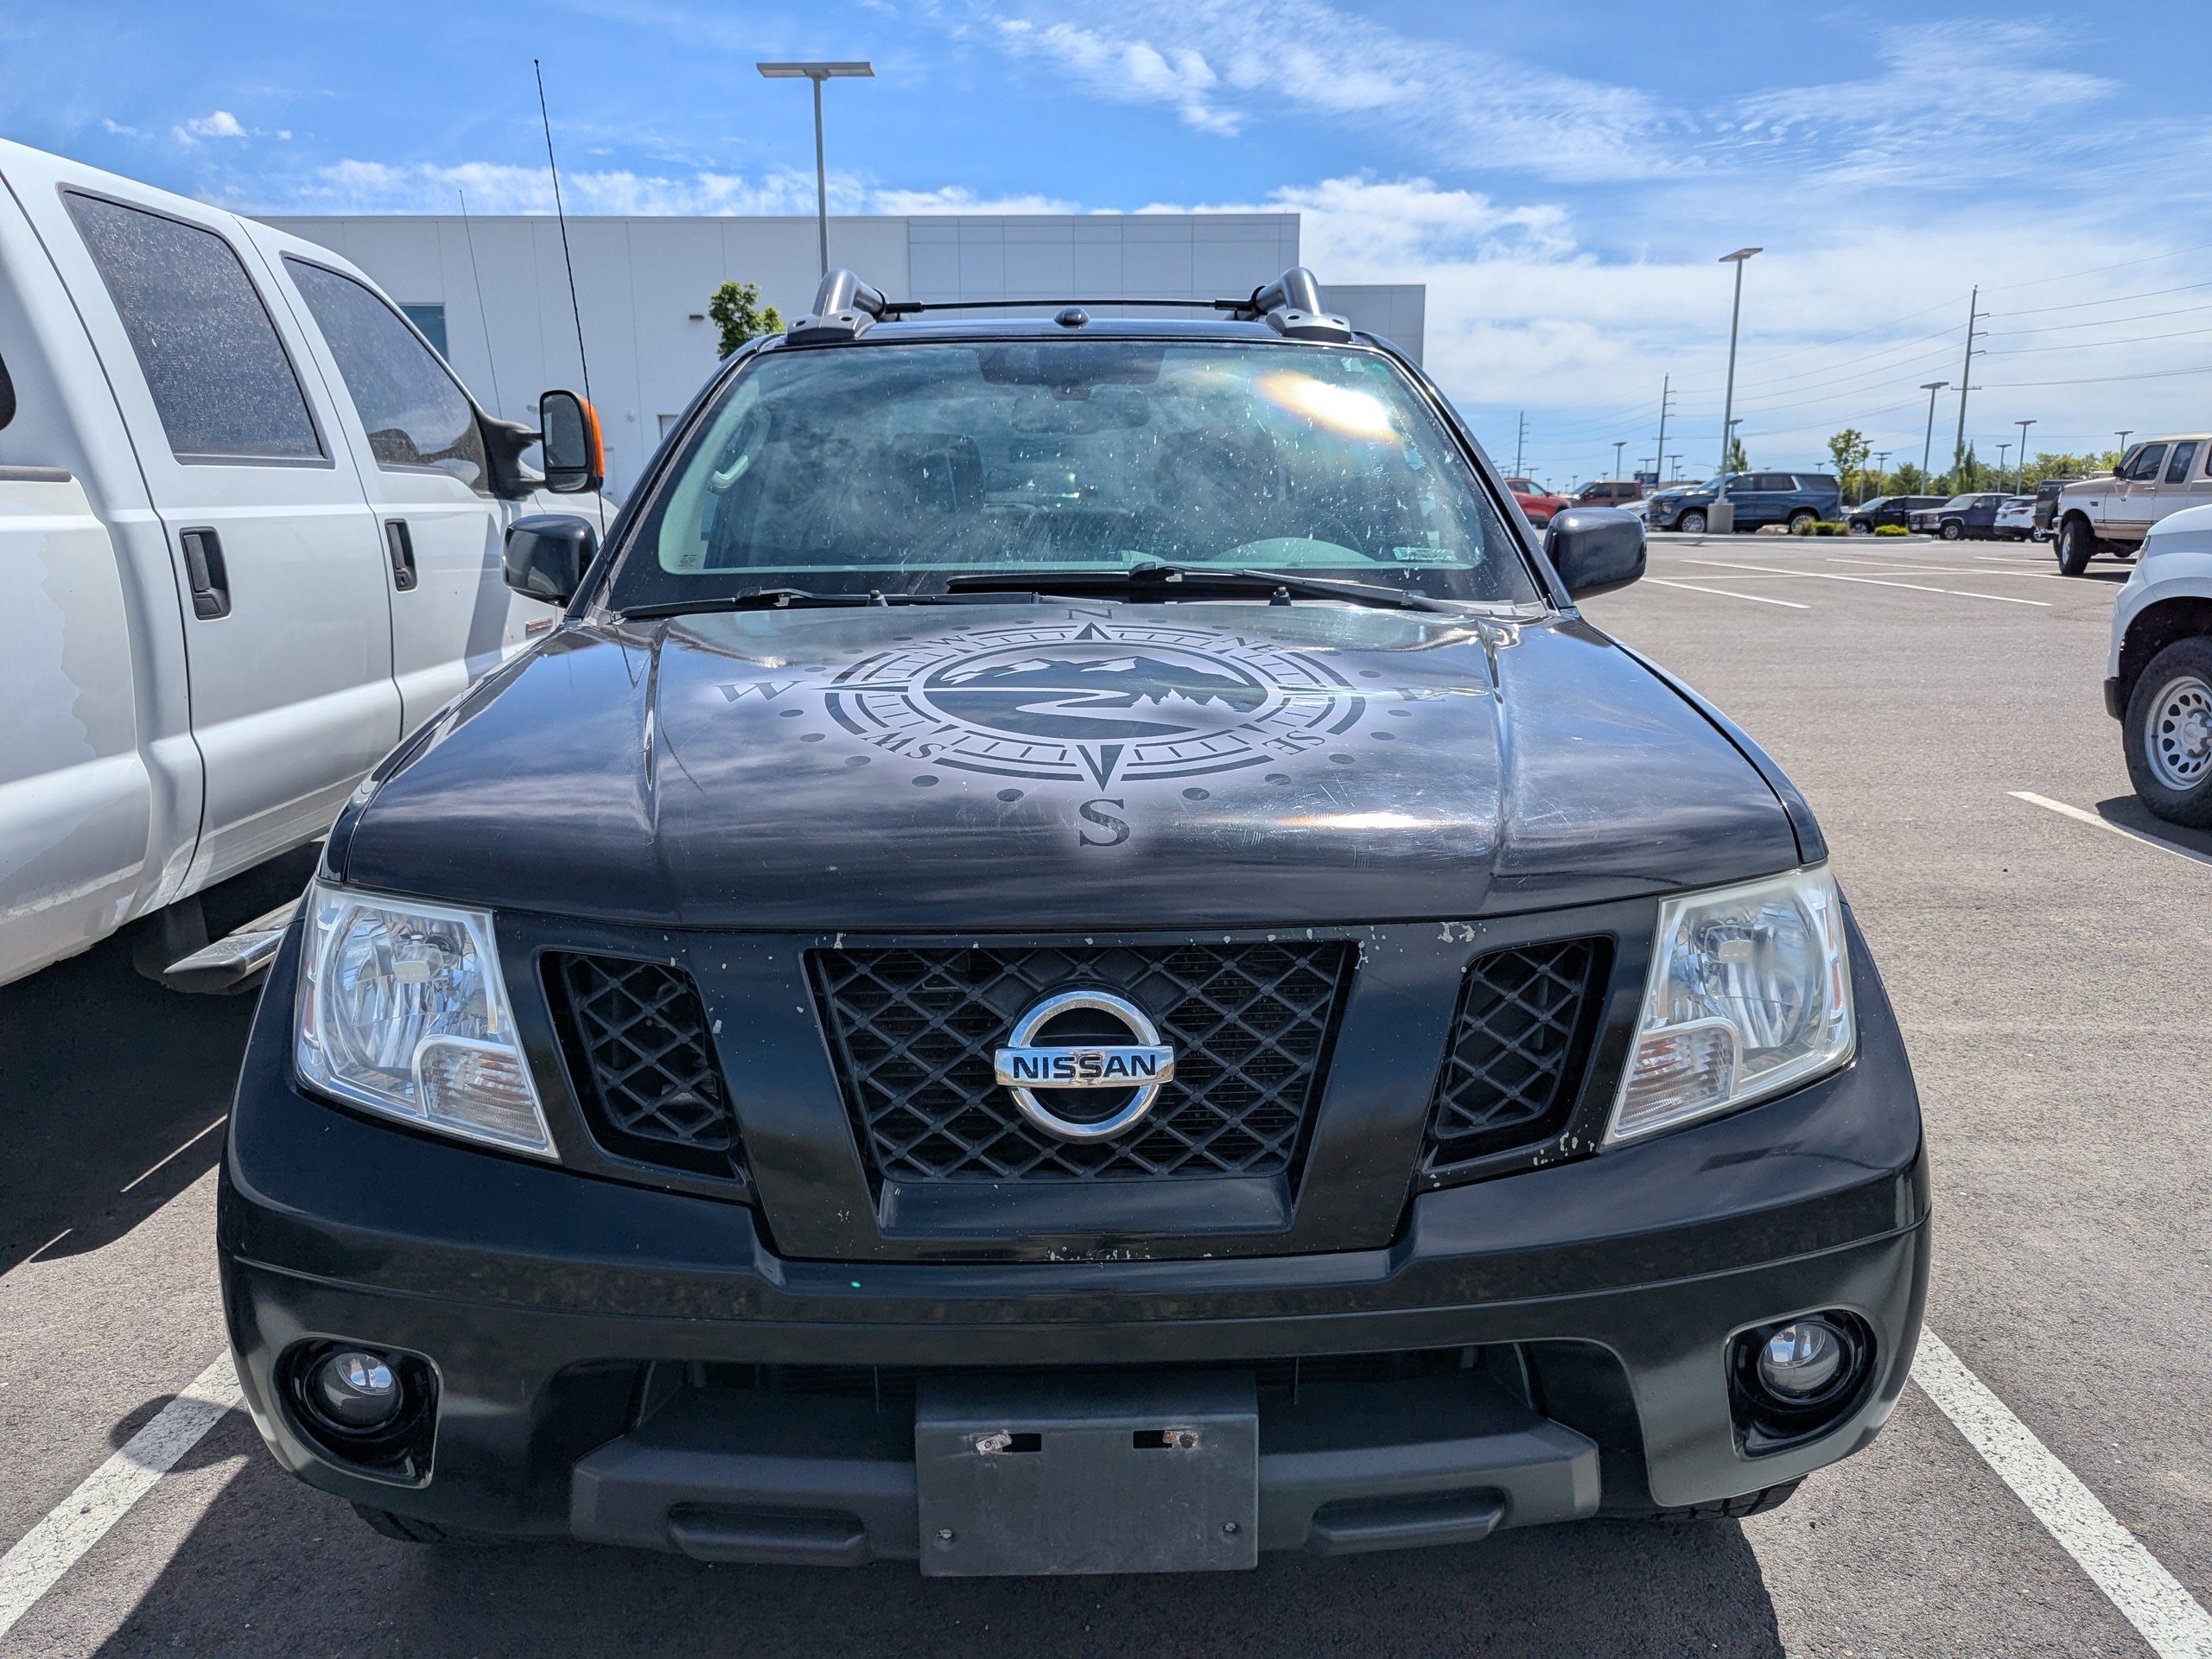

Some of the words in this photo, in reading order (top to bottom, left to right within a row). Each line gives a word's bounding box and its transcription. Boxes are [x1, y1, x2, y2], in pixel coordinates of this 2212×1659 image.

[1064, 608, 1113, 620] N
[713, 680, 809, 702] W
[1078, 798, 1130, 847] S
[1013, 1054, 1156, 1079] NISSAN
